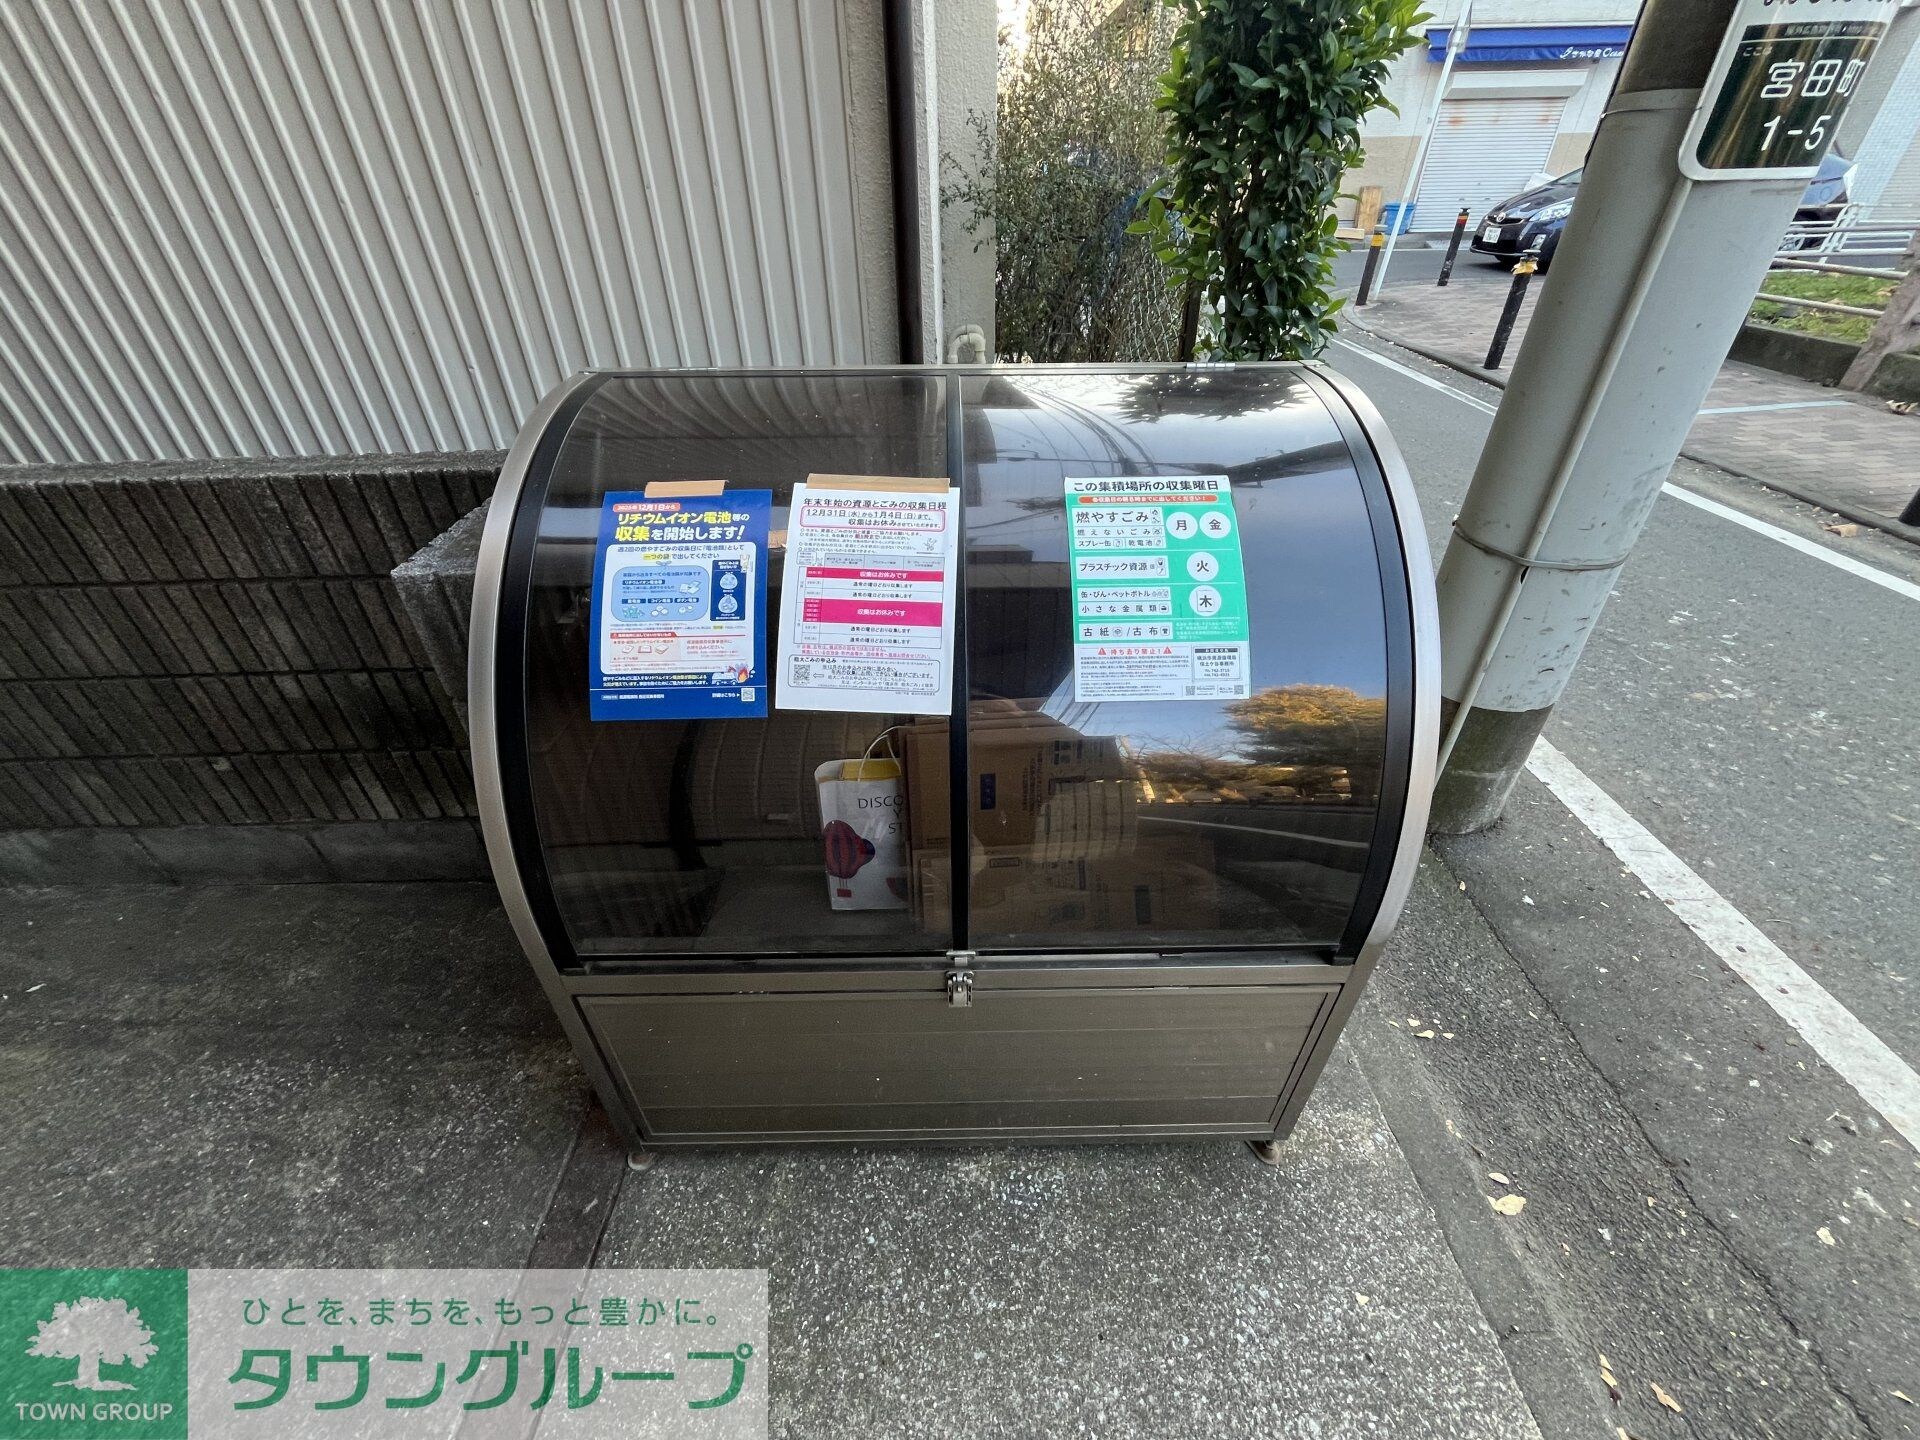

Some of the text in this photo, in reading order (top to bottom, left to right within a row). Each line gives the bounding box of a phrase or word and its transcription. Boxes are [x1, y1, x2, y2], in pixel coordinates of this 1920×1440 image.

[1761, 58, 1867, 99] 宮田町
[1761, 114, 1832, 152] 1-5
[1074, 480, 1219, 492] この集積場所の収集曜日
[804, 498, 947, 510] 年末年始の資源とごみの収集日程
[618, 512, 750, 525] リチウムイオン電池等の
[1076, 511, 1222, 531] 燃やすごみ 月 金
[1077, 528, 1150, 536] 燃えないごみ
[1078, 539, 1153, 547] スプレー缶 乾電池
[1079, 560, 1210, 573] プラスチック資源 火
[860, 571, 908, 579] 収集はお休みです
[1081, 590, 1213, 608] 缶・びん・ペットボトル 木
[857, 608, 906, 617] 収集はお休みです
[1081, 604, 1157, 613] 小さな金属類
[1083, 626, 1110, 637] 古紙
[1133, 626, 1159, 637] 古布
